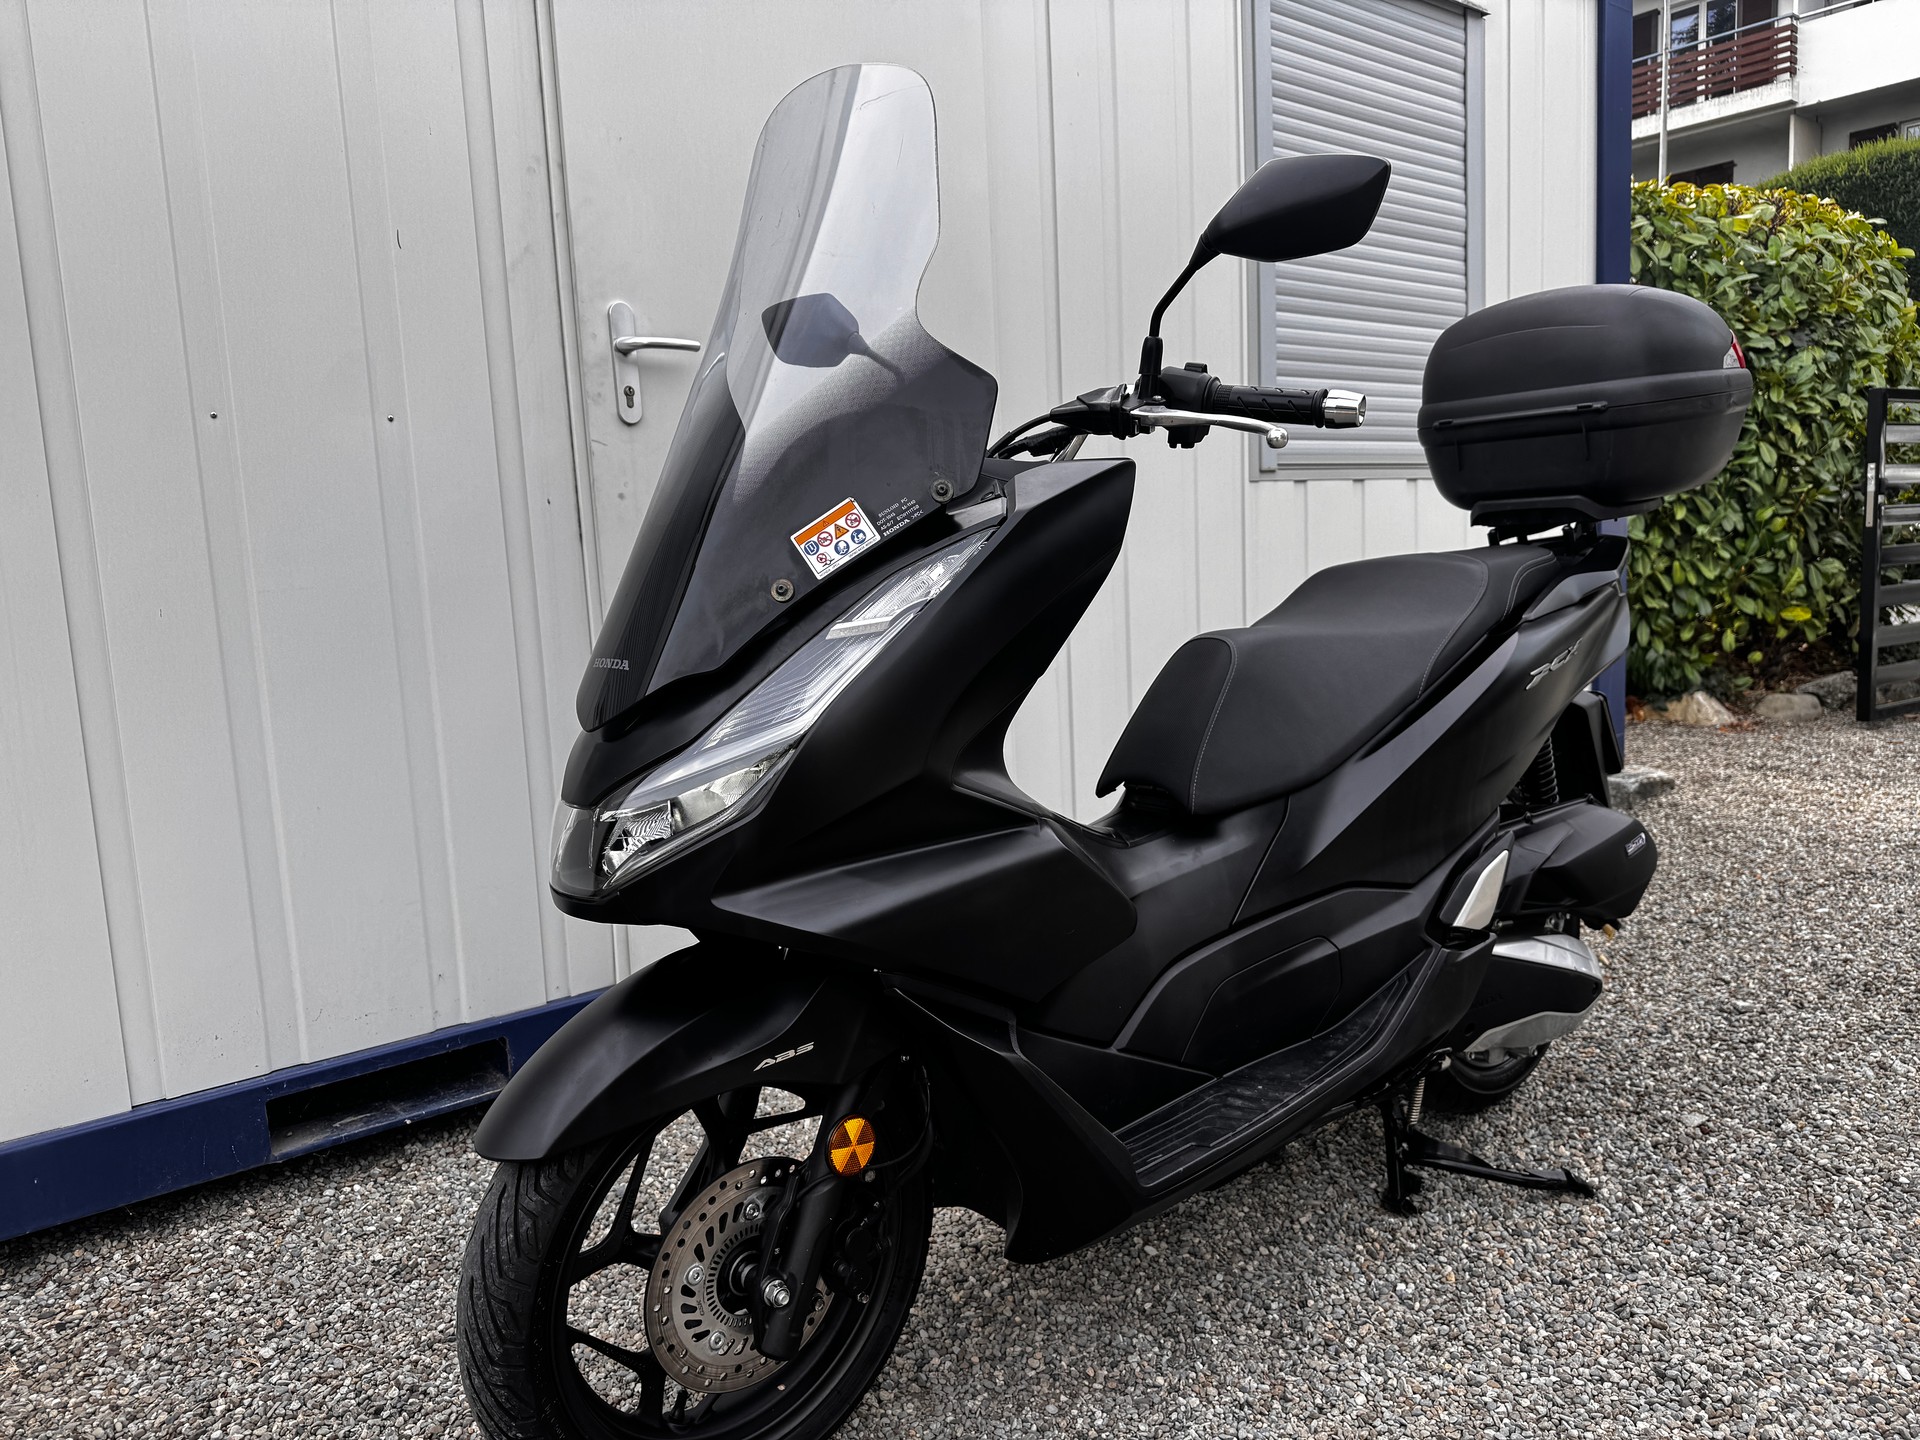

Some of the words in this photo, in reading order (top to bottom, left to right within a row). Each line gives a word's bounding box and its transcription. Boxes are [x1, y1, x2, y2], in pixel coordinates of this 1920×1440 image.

[883, 519, 911, 537] HONDA
[592, 658, 630, 671] HONDA
[753, 1041, 815, 1072] ABS
